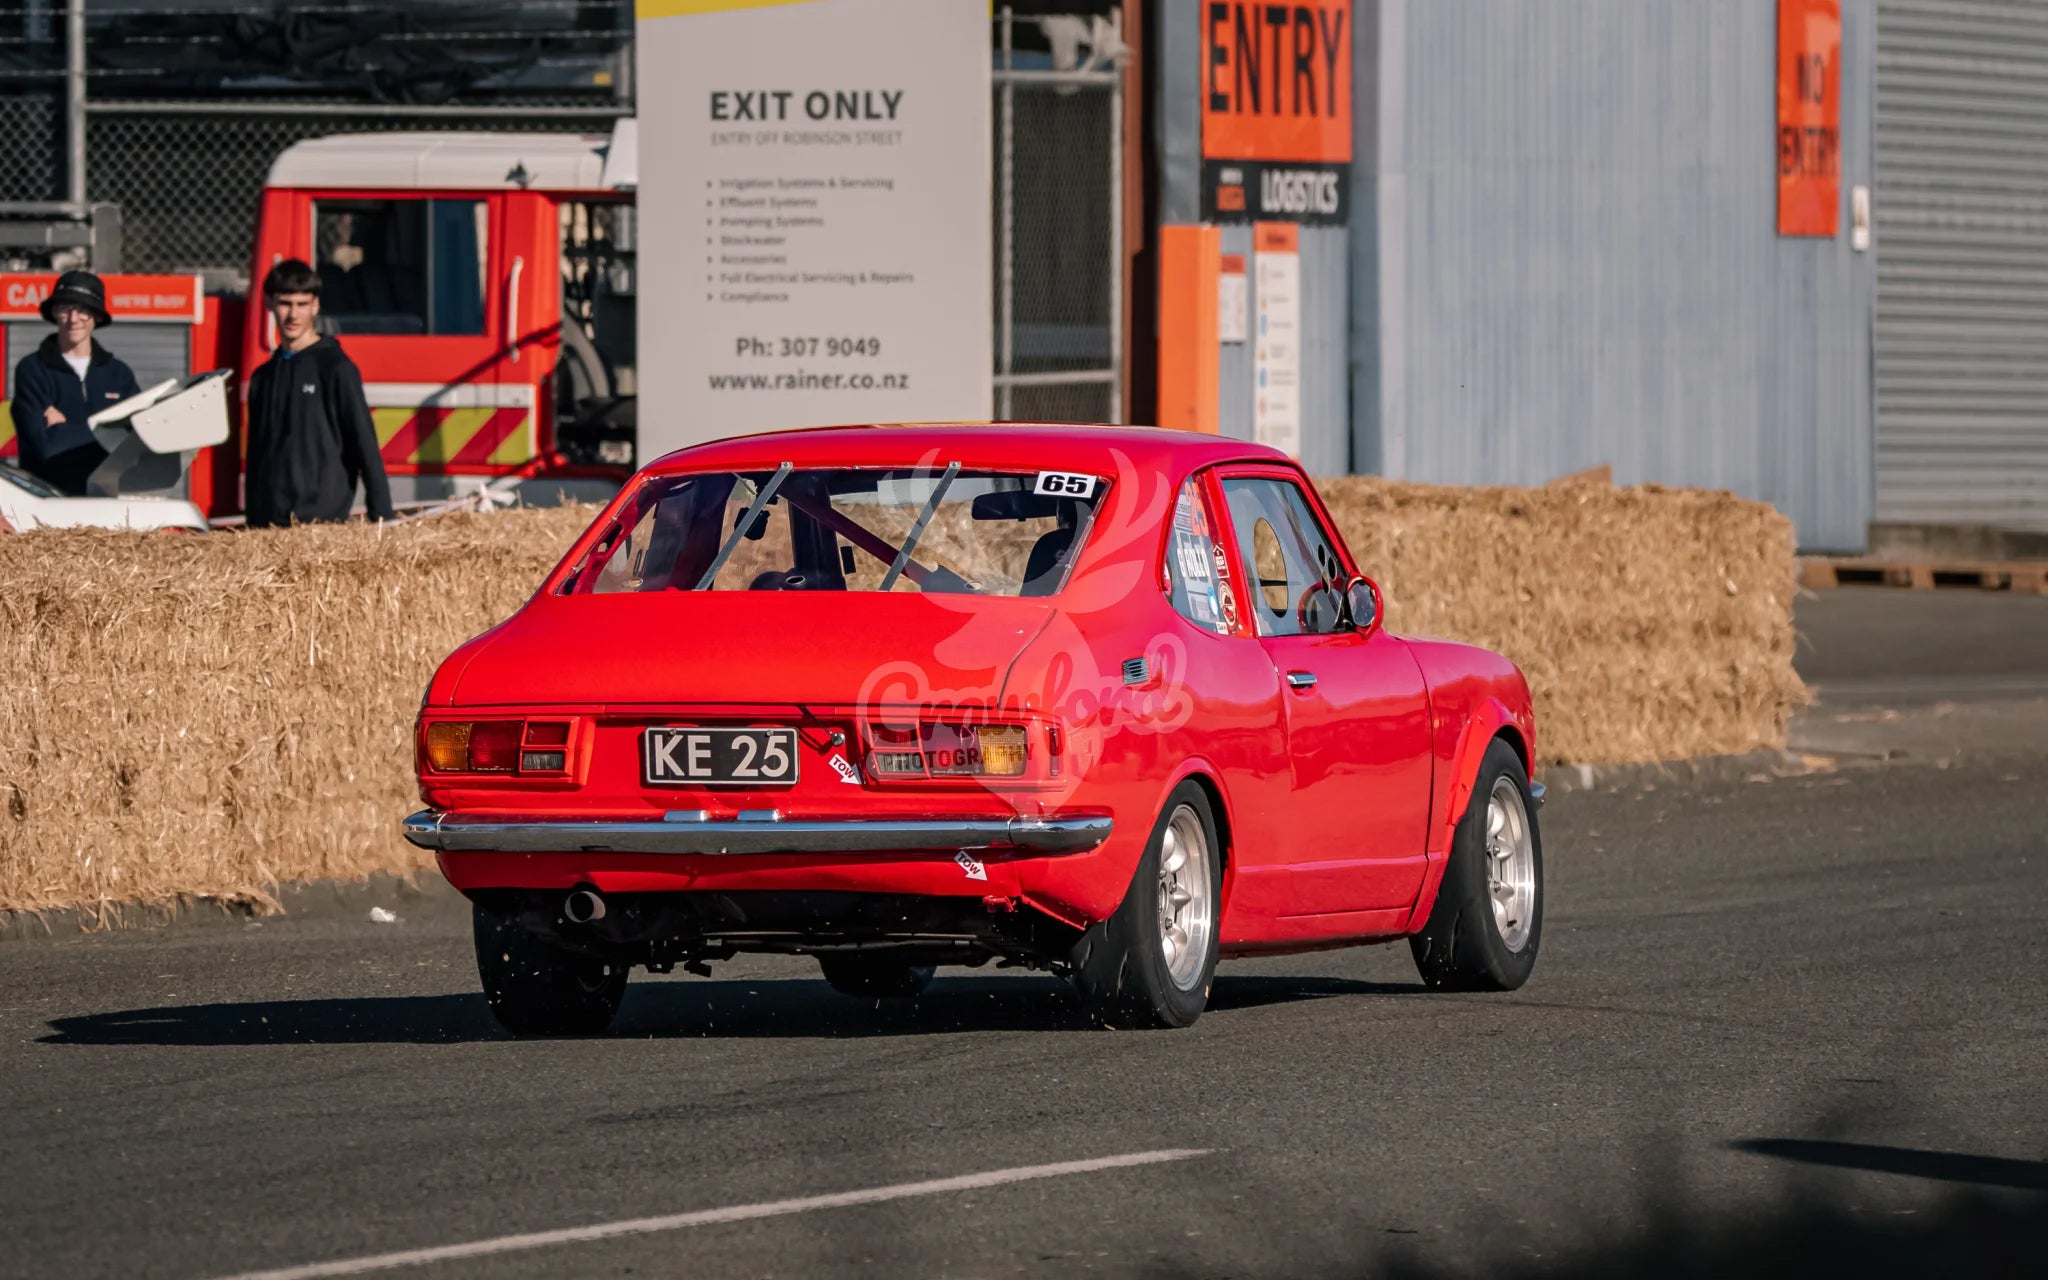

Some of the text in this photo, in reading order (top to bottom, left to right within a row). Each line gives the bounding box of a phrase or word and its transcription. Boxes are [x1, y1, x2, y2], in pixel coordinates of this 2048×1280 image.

[1209, 3, 1344, 118] ENTRY
[1797, 53, 1824, 104] NO
[710, 90, 904, 121] EXIT ONLY
[712, 131, 902, 146] ENTRY OFF ROBINSON STREET
[1780, 126, 1837, 176] ENTRY
[720, 177, 894, 191] Irrigation Systems & Servicing
[1261, 169, 1339, 214] LOGISTICS
[720, 197, 818, 210] Effluent Systems
[776, 216, 824, 229] Systems
[721, 272, 914, 286] Full Electrical Servicing & Repairs
[721, 292, 789, 304] Compliance
[736, 336, 881, 357] Ph: 307 9049
[709, 369, 909, 390] www.rainer.co.nz
[1042, 475, 1088, 494] 65
[654, 734, 789, 777] KE 25
[833, 757, 855, 778] TOW
[958, 853, 981, 875] TOW
